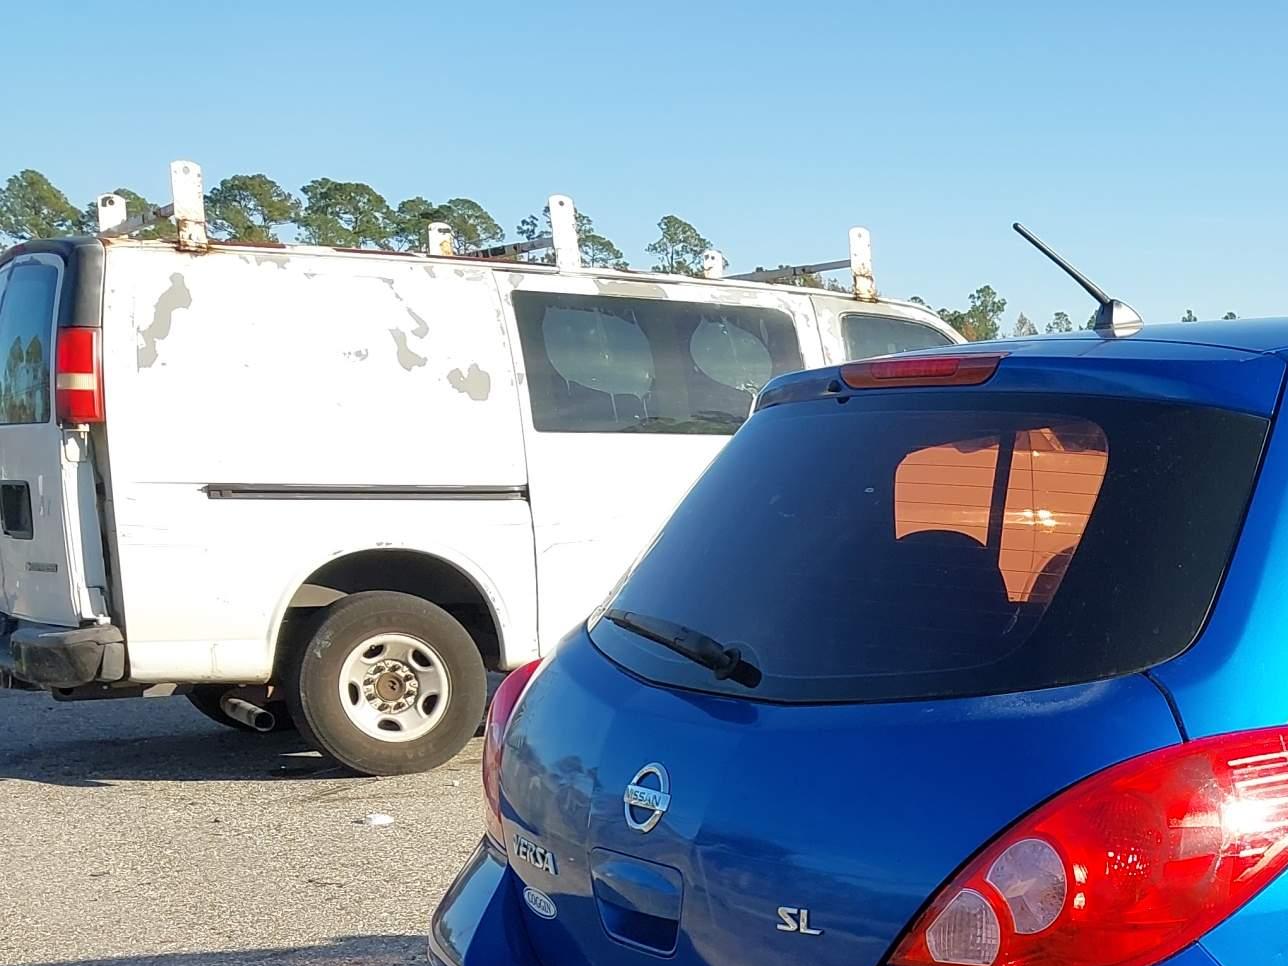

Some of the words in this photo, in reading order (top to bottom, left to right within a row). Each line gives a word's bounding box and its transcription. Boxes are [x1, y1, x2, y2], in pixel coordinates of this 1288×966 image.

[627, 786, 662, 808] NISSAN
[513, 834, 558, 875] VERSA
[776, 906, 822, 935] SL
